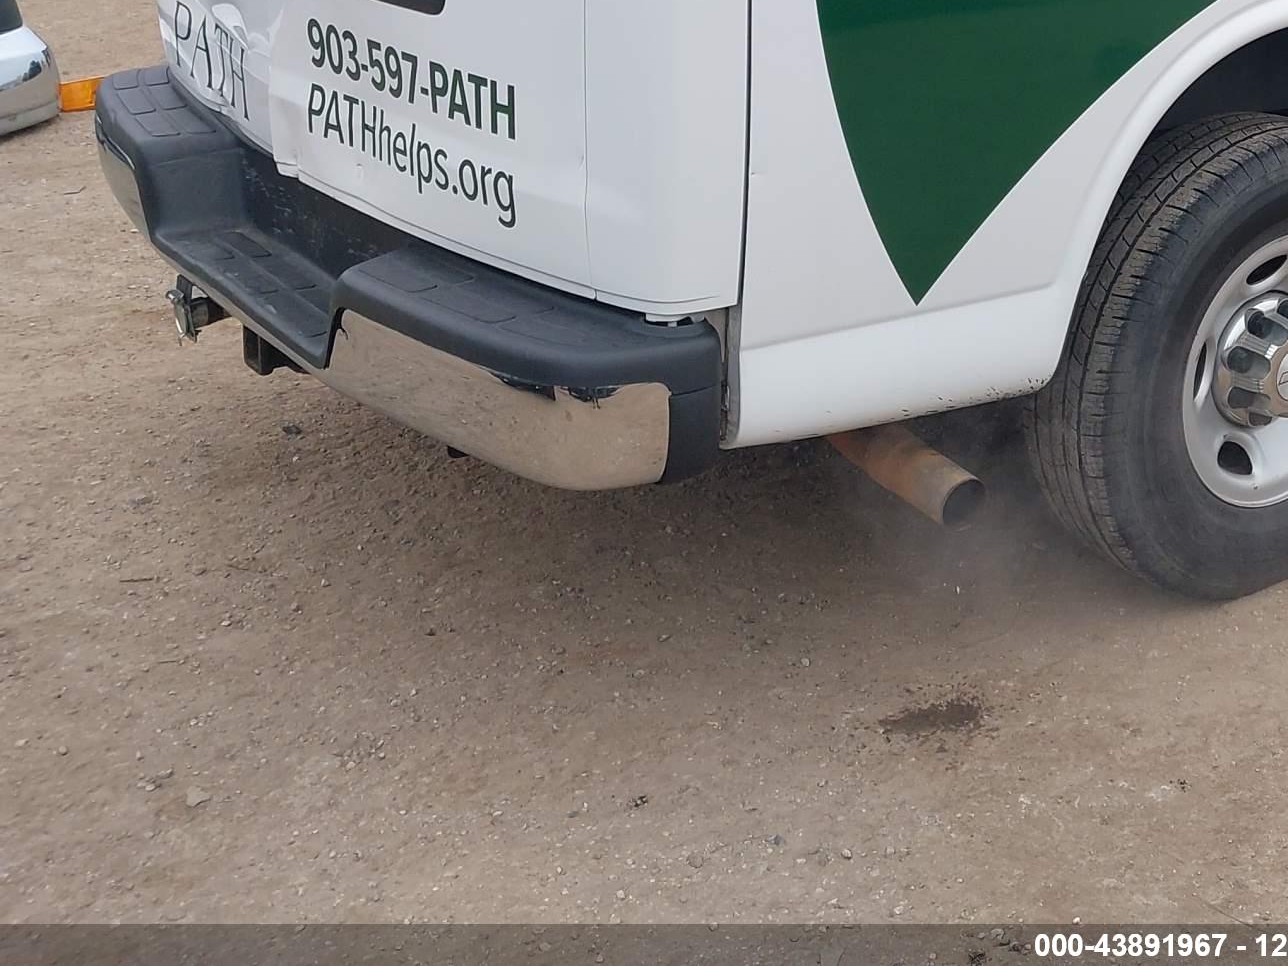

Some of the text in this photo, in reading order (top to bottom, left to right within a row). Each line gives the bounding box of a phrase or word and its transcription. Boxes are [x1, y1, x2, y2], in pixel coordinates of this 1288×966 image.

[173, 0, 251, 120] PATH
[307, 18, 517, 140] 903-597-PATH
[308, 83, 517, 228] PATHhelps.org
